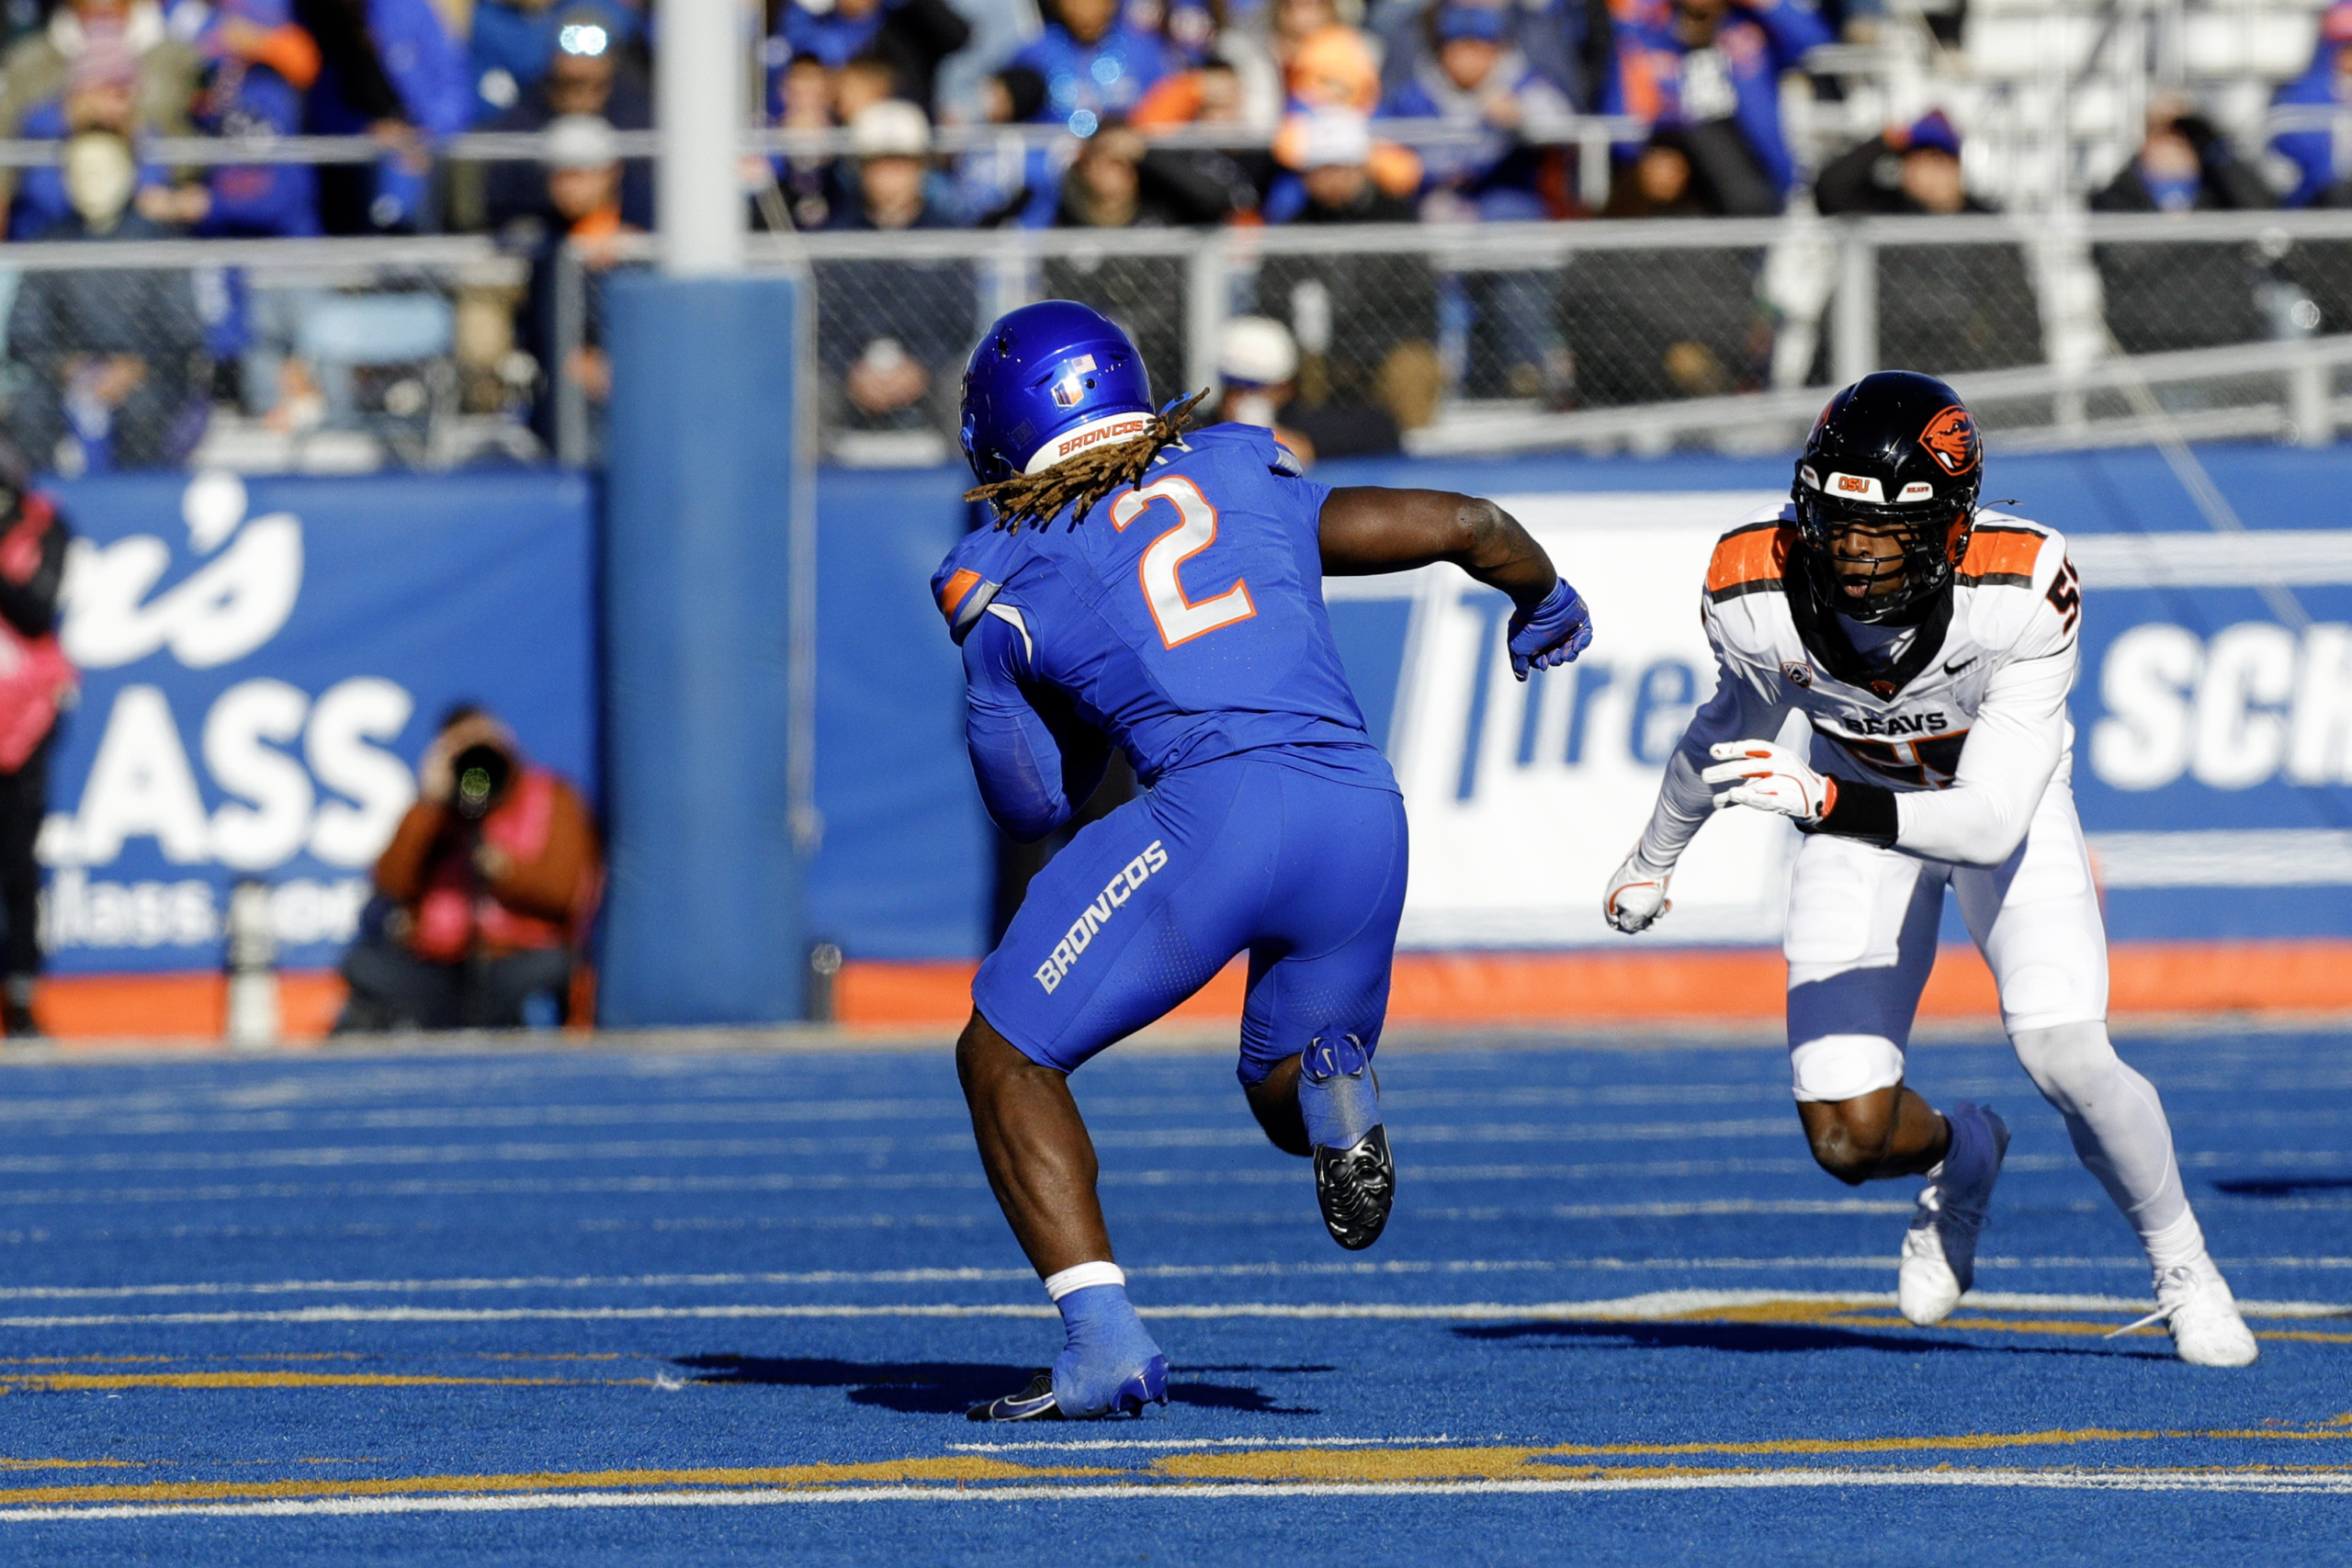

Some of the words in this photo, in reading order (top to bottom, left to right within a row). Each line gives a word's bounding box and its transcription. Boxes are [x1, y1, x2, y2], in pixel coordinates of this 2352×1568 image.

[1058, 420, 1144, 457] BRONCOS
[1838, 476, 1870, 493] OSU
[1110, 474, 1258, 650] 2
[1841, 711, 1948, 736] BEAVS
[35, 676, 418, 869] ASS
[1033, 840, 1170, 996] BRONCOS
